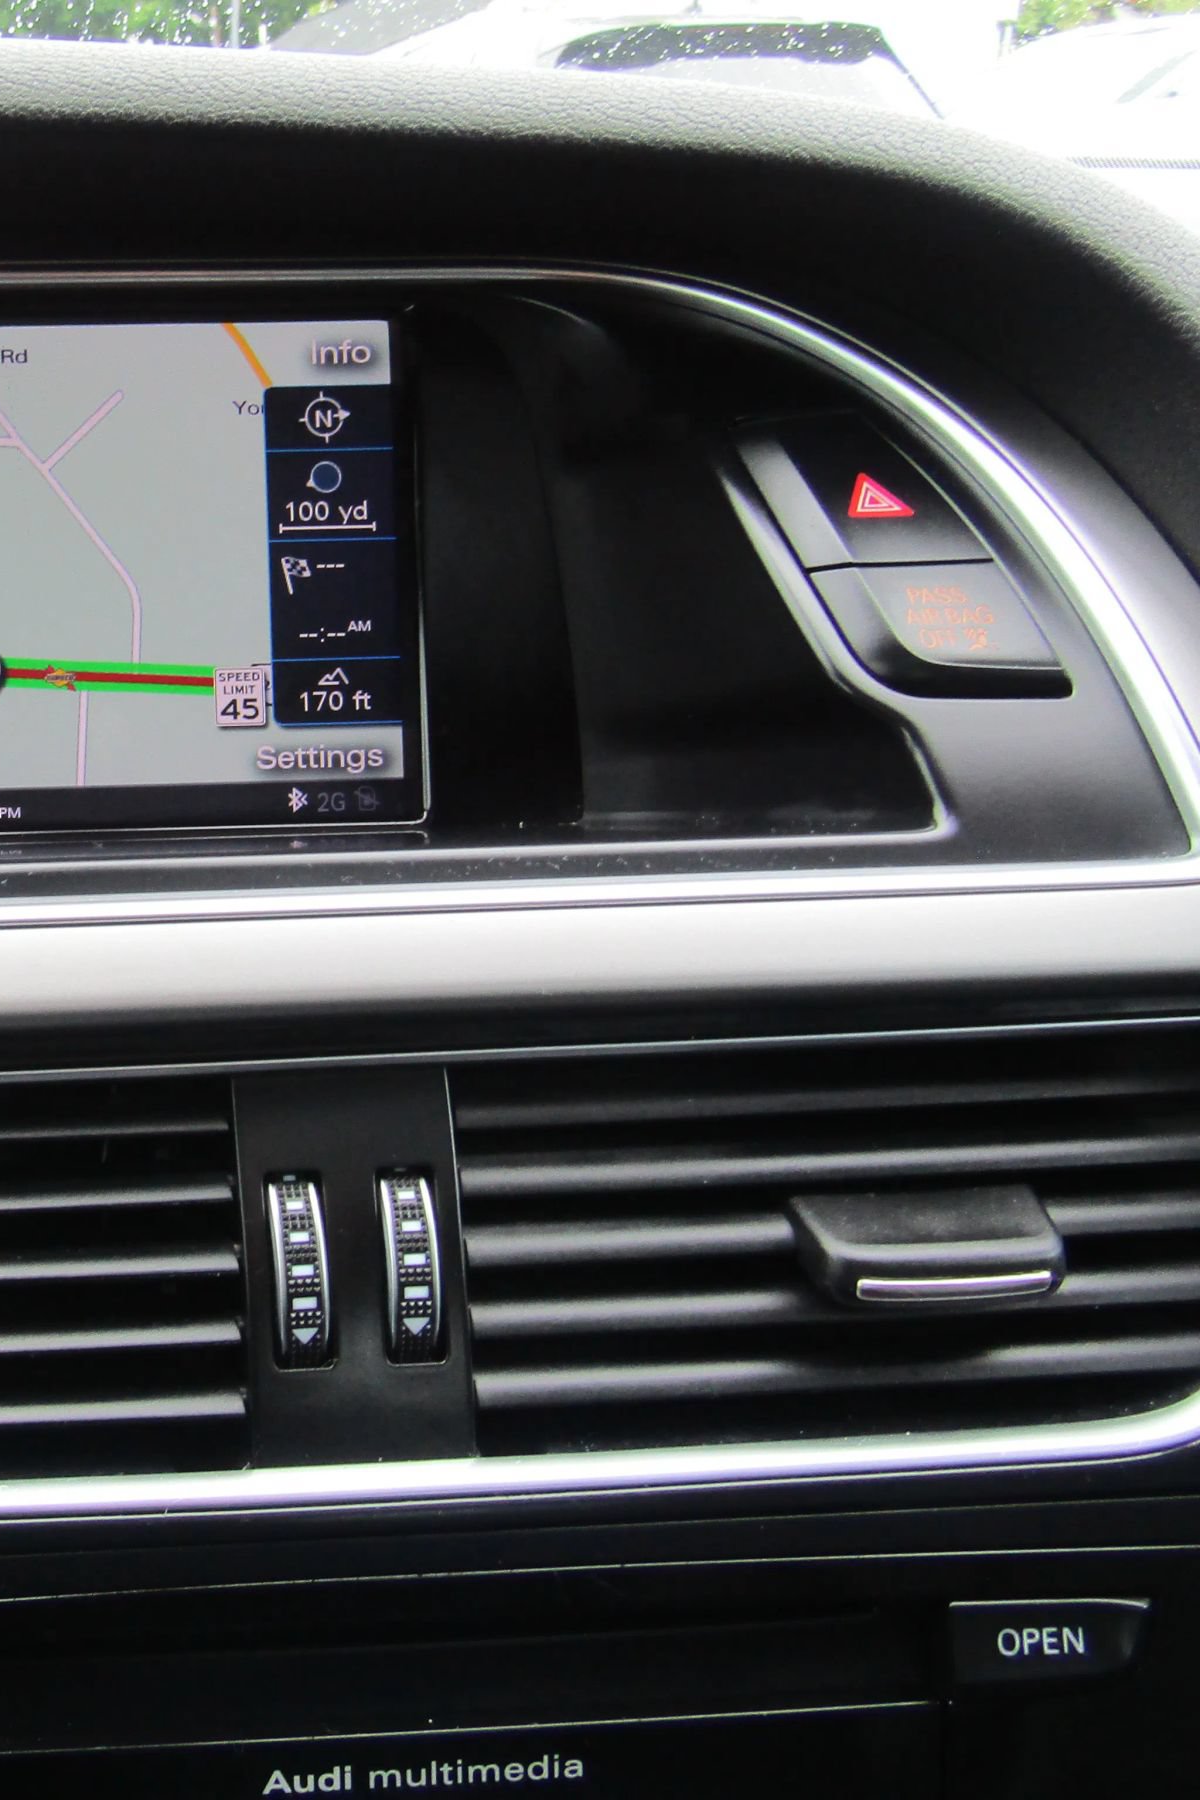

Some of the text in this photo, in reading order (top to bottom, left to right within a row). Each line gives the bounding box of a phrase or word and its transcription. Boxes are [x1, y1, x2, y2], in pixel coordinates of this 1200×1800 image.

[0, 350, 28, 364] Rd
[311, 339, 372, 366] Info
[285, 501, 369, 526] 100 yd
[219, 672, 260, 682] SPEED
[223, 685, 255, 695] LIMIT
[300, 690, 372, 711] 170 ft
[220, 698, 260, 720] 45
[256, 745, 384, 773] Settings
[317, 792, 346, 812] 2G
[996, 1627, 1086, 1657] OPEN
[262, 1754, 586, 1796] Audi multimedia
